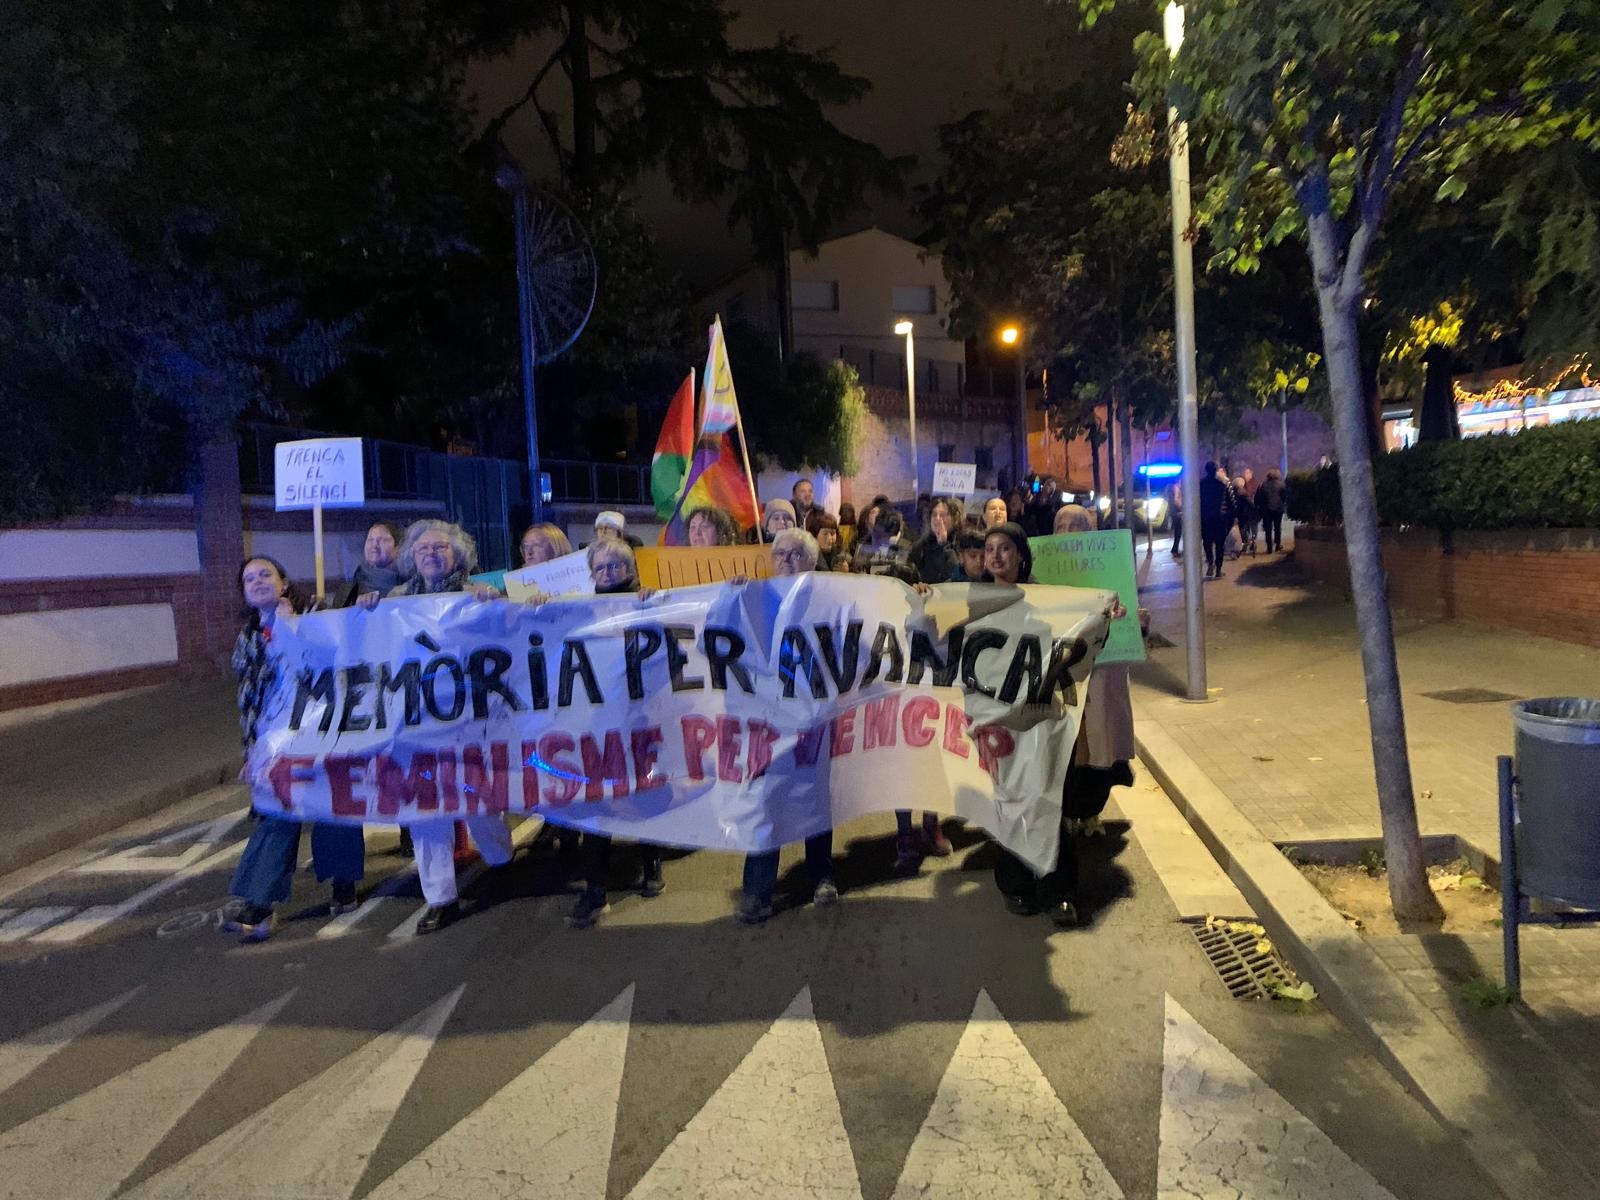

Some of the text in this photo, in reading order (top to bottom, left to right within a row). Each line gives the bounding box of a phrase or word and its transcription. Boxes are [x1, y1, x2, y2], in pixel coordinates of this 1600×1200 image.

[285, 482, 346, 501] SILENCI
[306, 466, 324, 480] EL
[623, 622, 756, 701] PER
[269, 723, 668, 817] FEMINISME
